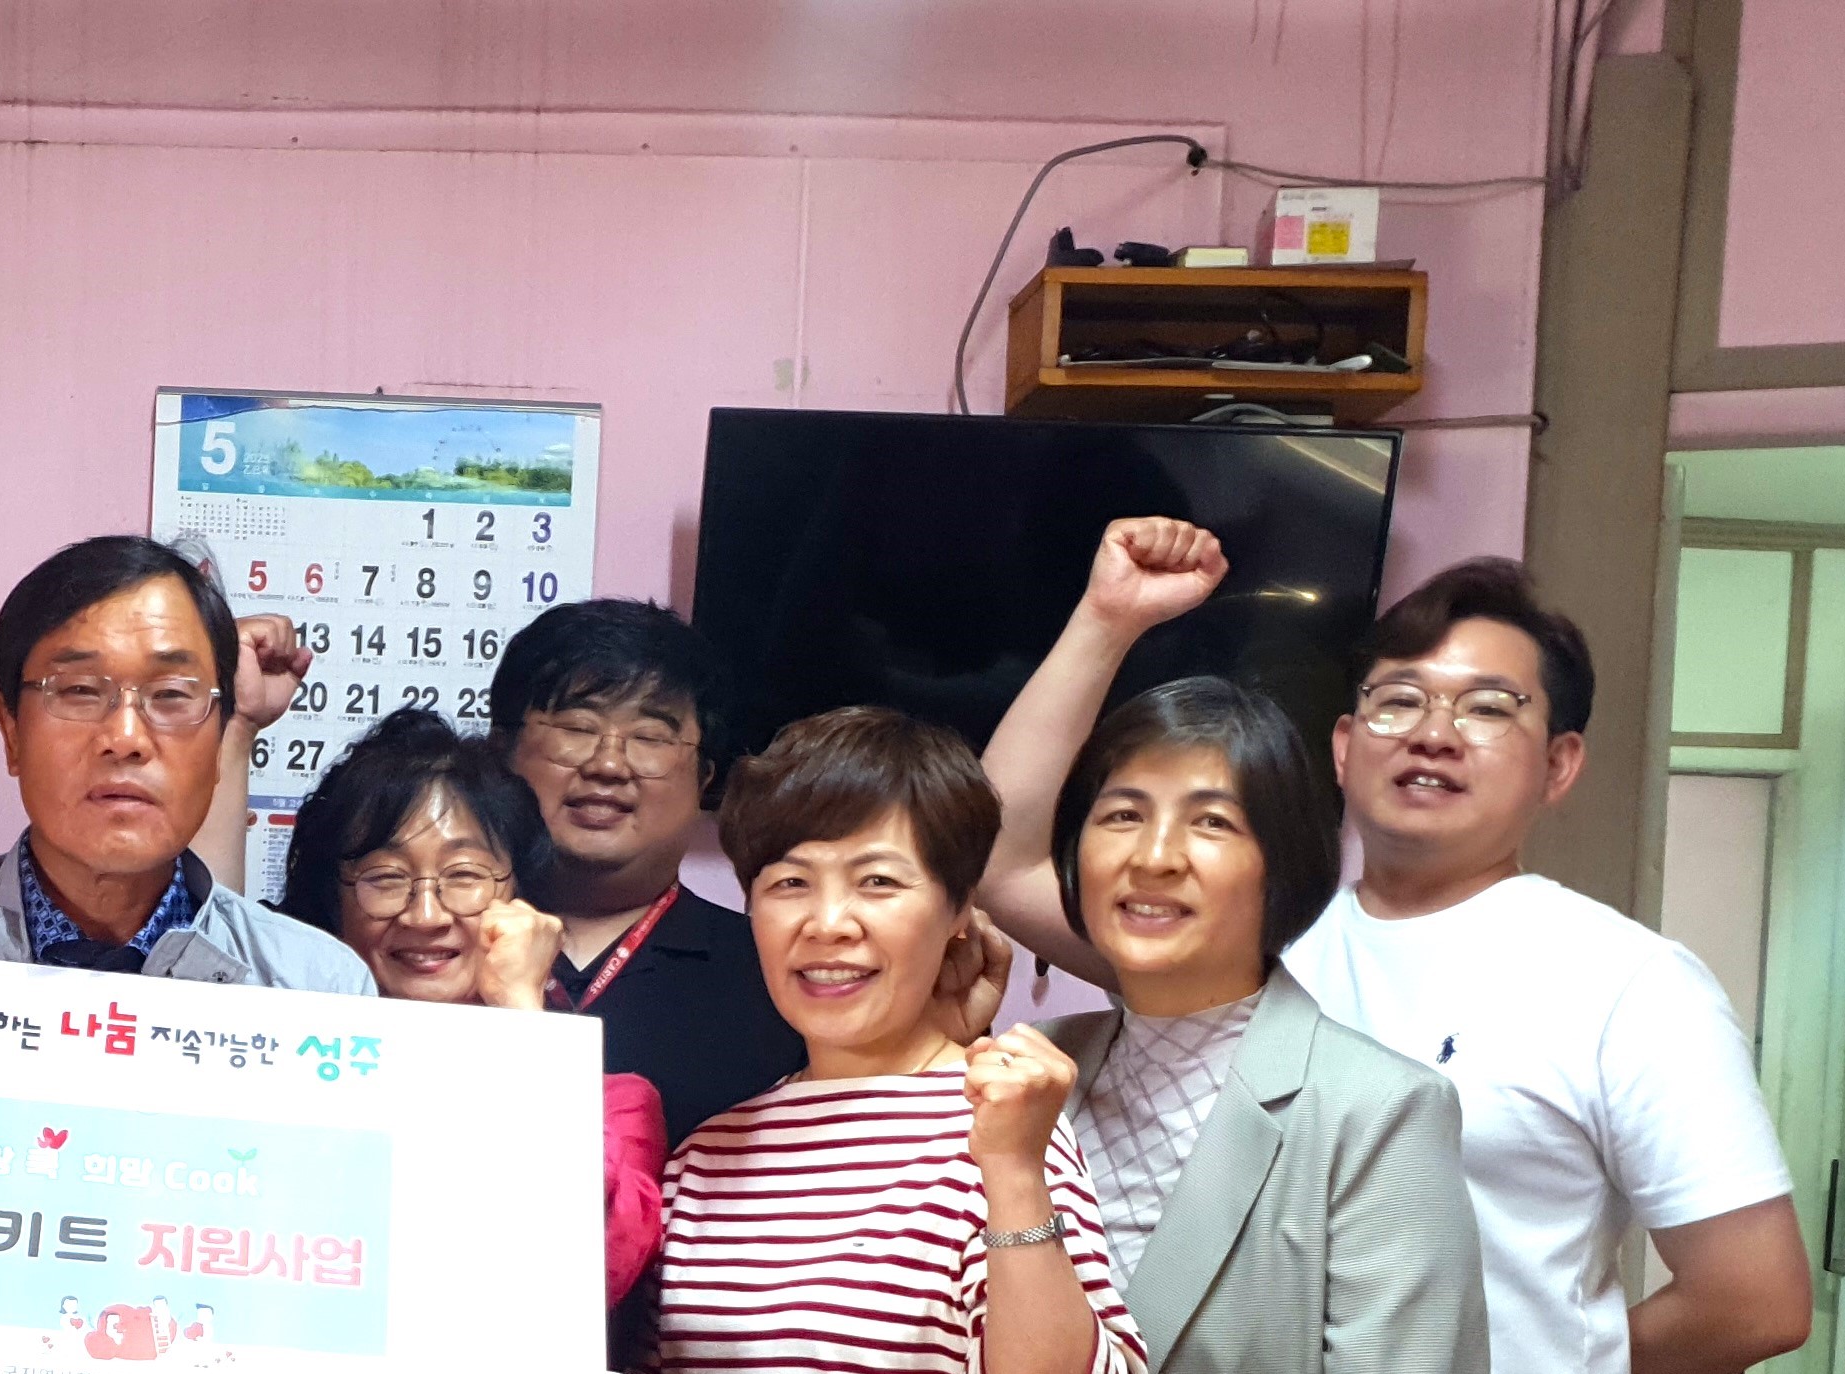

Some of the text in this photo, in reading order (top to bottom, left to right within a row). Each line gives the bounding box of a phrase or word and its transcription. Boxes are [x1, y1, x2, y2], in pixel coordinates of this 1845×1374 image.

[201, 420, 236, 475] 5
[421, 508, 552, 544] 1 2 3
[248, 560, 268, 592] 5
[304, 562, 324, 594] 6
[362, 565, 380, 597] 7
[416, 567, 436, 599] 8
[473, 569, 492, 601] 9
[522, 571, 558, 603] 10
[295, 622, 331, 654] 13
[350, 625, 386, 656] 14
[406, 627, 442, 658] 15
[462, 628, 498, 660] 16
[290, 681, 328, 712] 20
[345, 683, 380, 715] 21
[457, 687, 492, 719] 23
[250, 737, 326, 771] 6 27
[589, 957, 622, 995] CARITAS
[60, 1001, 137, 1056] 나눔
[150, 1025, 279, 1069] 지속가능한
[295, 1035, 382, 1081] 성주
[82, 1153, 154, 1188] 희망
[164, 1161, 261, 1198] Cook
[137, 1223, 363, 1287] 지원사업
